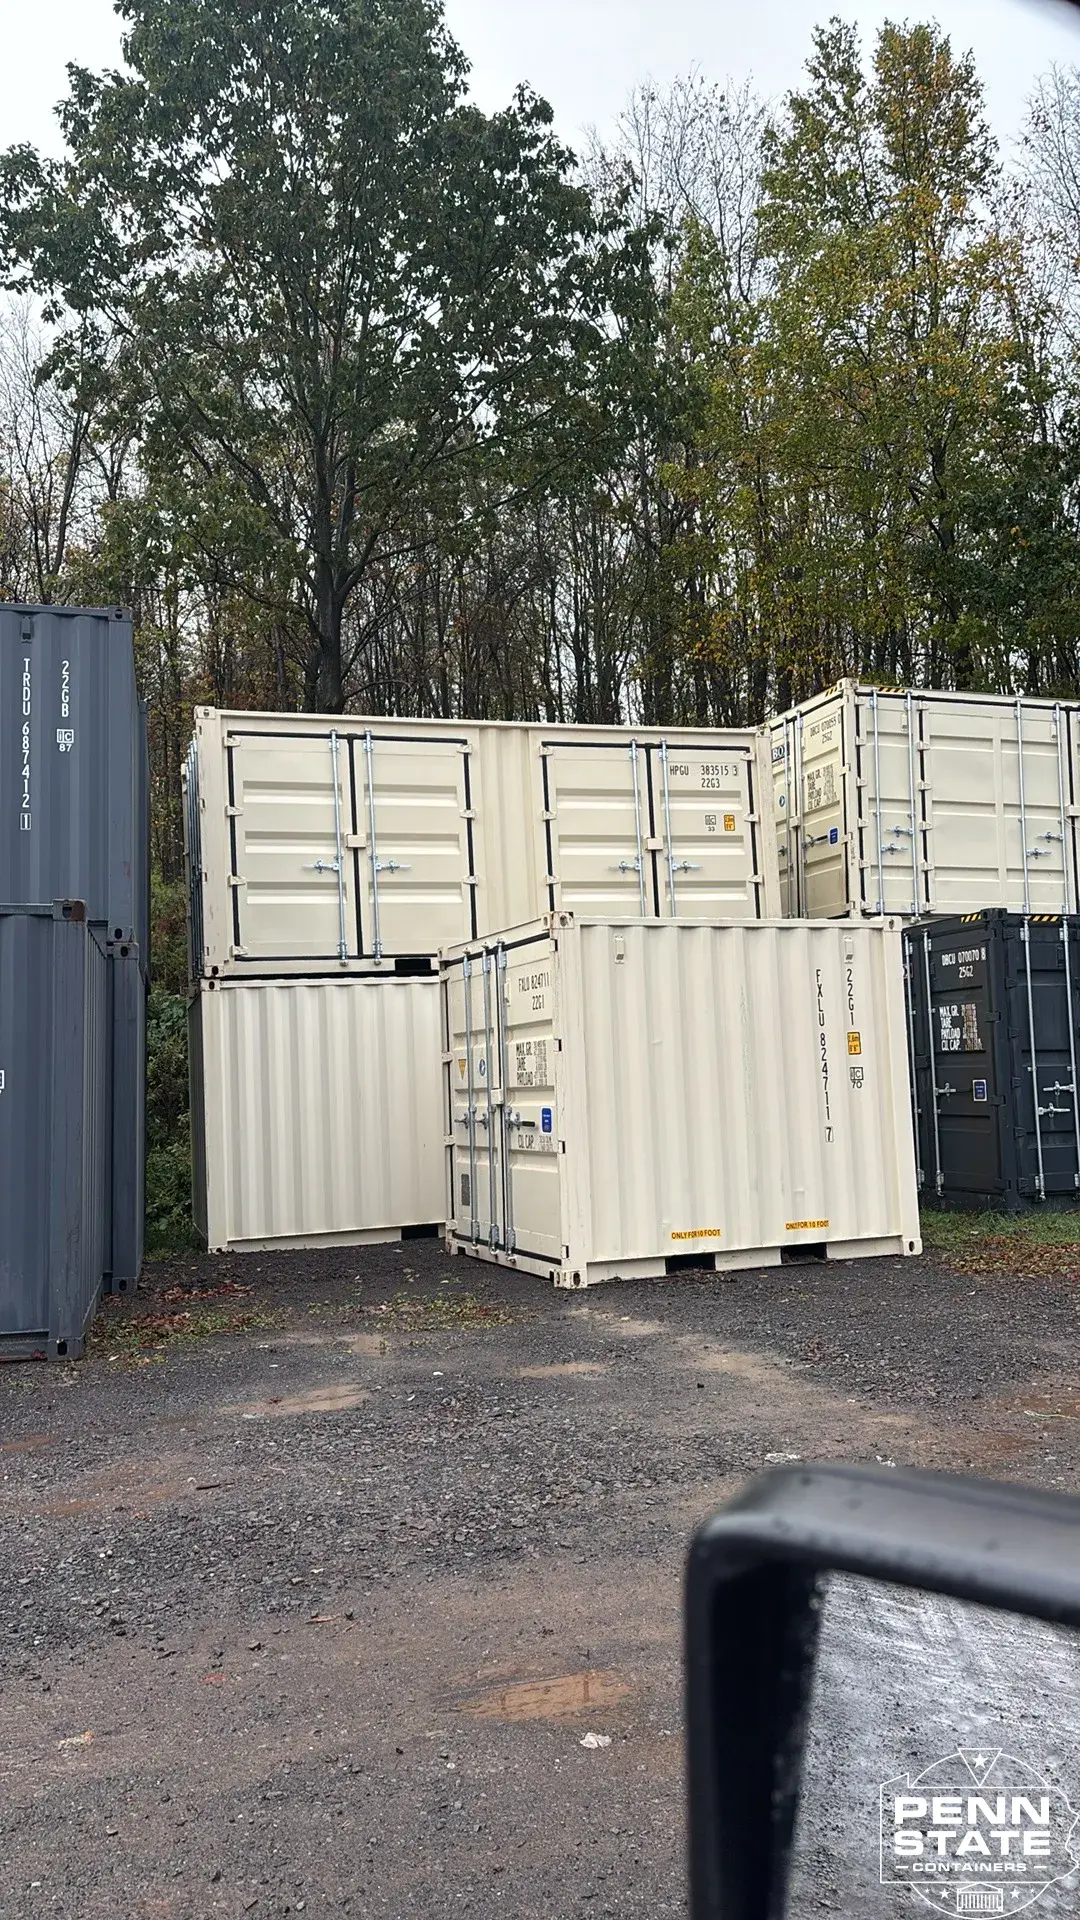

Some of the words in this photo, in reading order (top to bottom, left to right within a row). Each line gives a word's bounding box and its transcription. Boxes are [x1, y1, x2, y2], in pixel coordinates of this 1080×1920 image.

[22, 658, 31, 716] TRDU
[61, 660, 70, 718] 22GB
[58, 743, 73, 752] 87
[21, 721, 31, 808] 687412
[669, 765, 689, 776] HPGU
[700, 765, 729, 776] 383515
[732, 765, 738, 776] 3
[701, 778, 720, 788] 22G3
[957, 949, 980, 963] 070070
[958, 965, 974, 979] 25G2
[532, 994, 545, 1011] 22G1
[816, 969, 825, 1027] FXLU
[846, 968, 854, 1025] 22G1
[940, 1027, 961, 1040] PAYLOAD
[516, 1070, 534, 1086] PAYLOAD
[820, 1032, 830, 1120] 824711
[851, 1080, 863, 1089] 70
[809, 1219, 817, 1229] 10
[671, 1230, 688, 1240] ONLY
[687, 1230, 697, 1239] FOR
[697, 1229, 704, 1238] 10
[704, 1227, 721, 1238] FOOT
